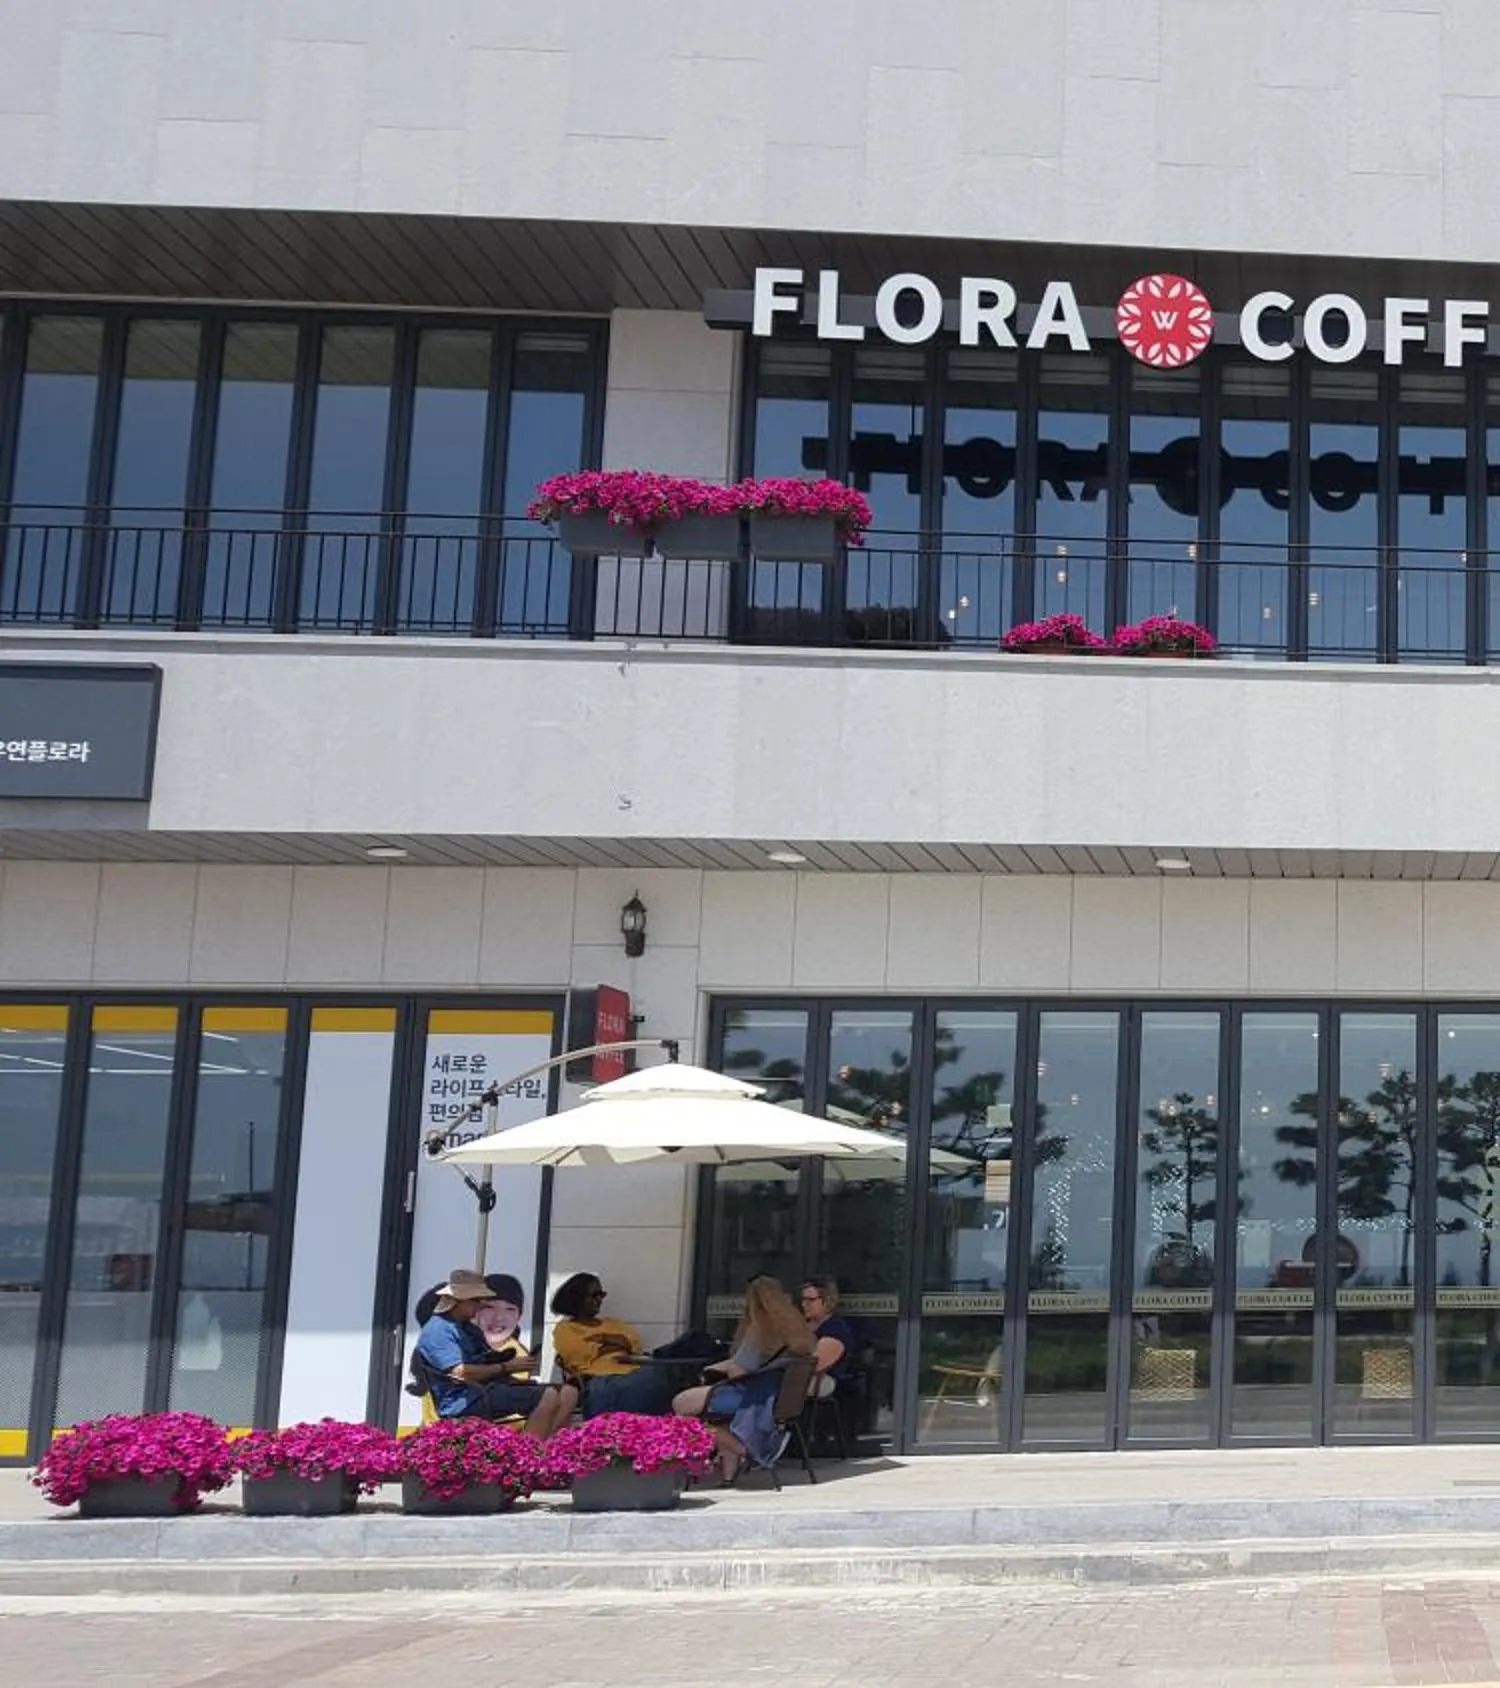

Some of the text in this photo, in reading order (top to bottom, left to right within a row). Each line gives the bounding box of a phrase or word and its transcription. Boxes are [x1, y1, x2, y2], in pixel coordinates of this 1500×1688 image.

[752, 267, 1091, 351] FLORA
[1150, 310, 1179, 331] W
[431, 1053, 487, 1074] 새로운
